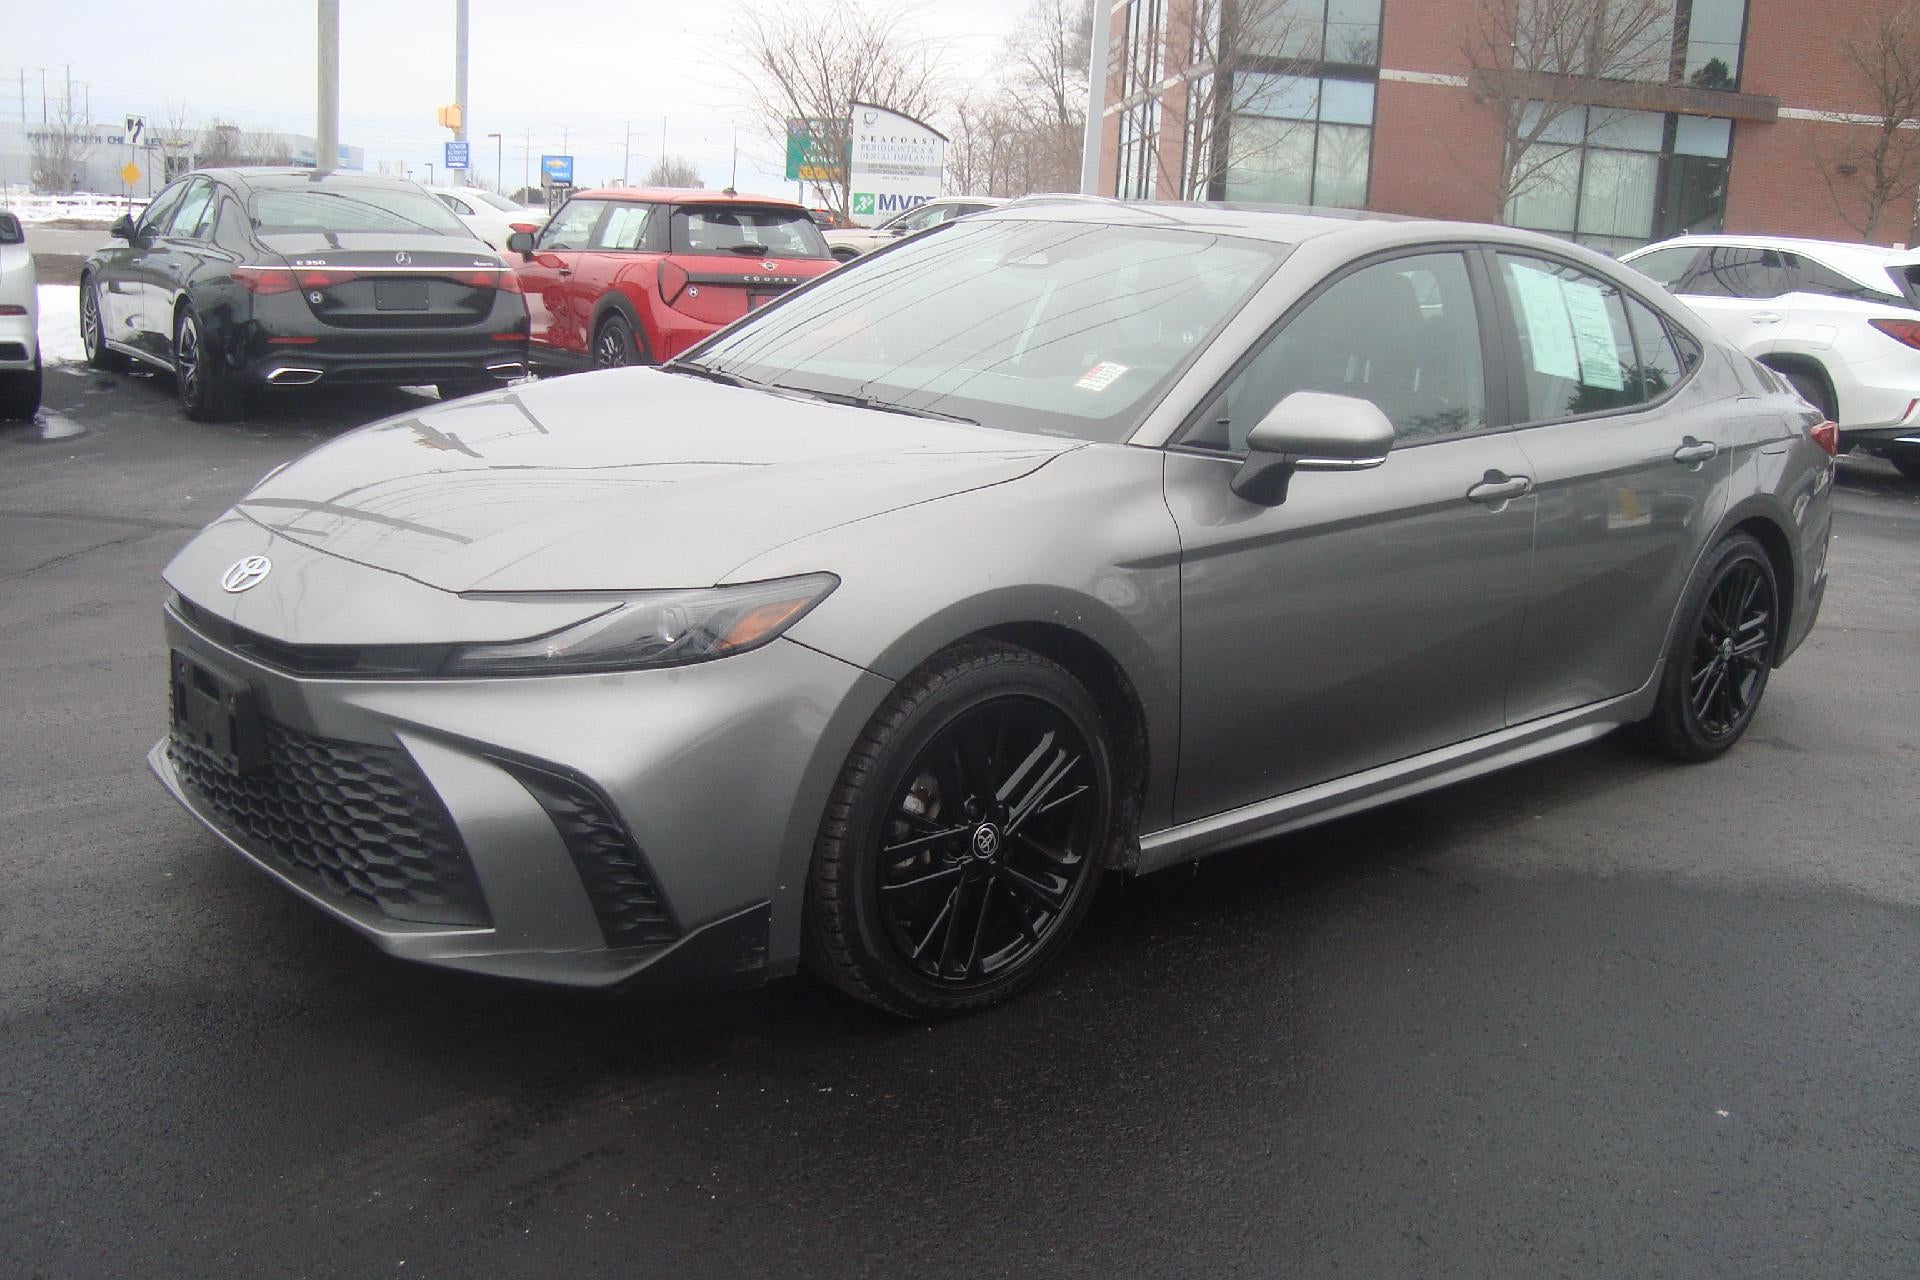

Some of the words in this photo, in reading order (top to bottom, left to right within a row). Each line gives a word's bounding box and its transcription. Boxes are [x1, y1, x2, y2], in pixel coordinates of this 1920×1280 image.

[861, 135, 937, 145] SEACOAST
[861, 144, 926, 154] PERIODONTICS
[860, 151, 891, 160] DENTAL
[894, 153, 935, 163] IMPLANTS
[743, 275, 798, 283] COOPER
